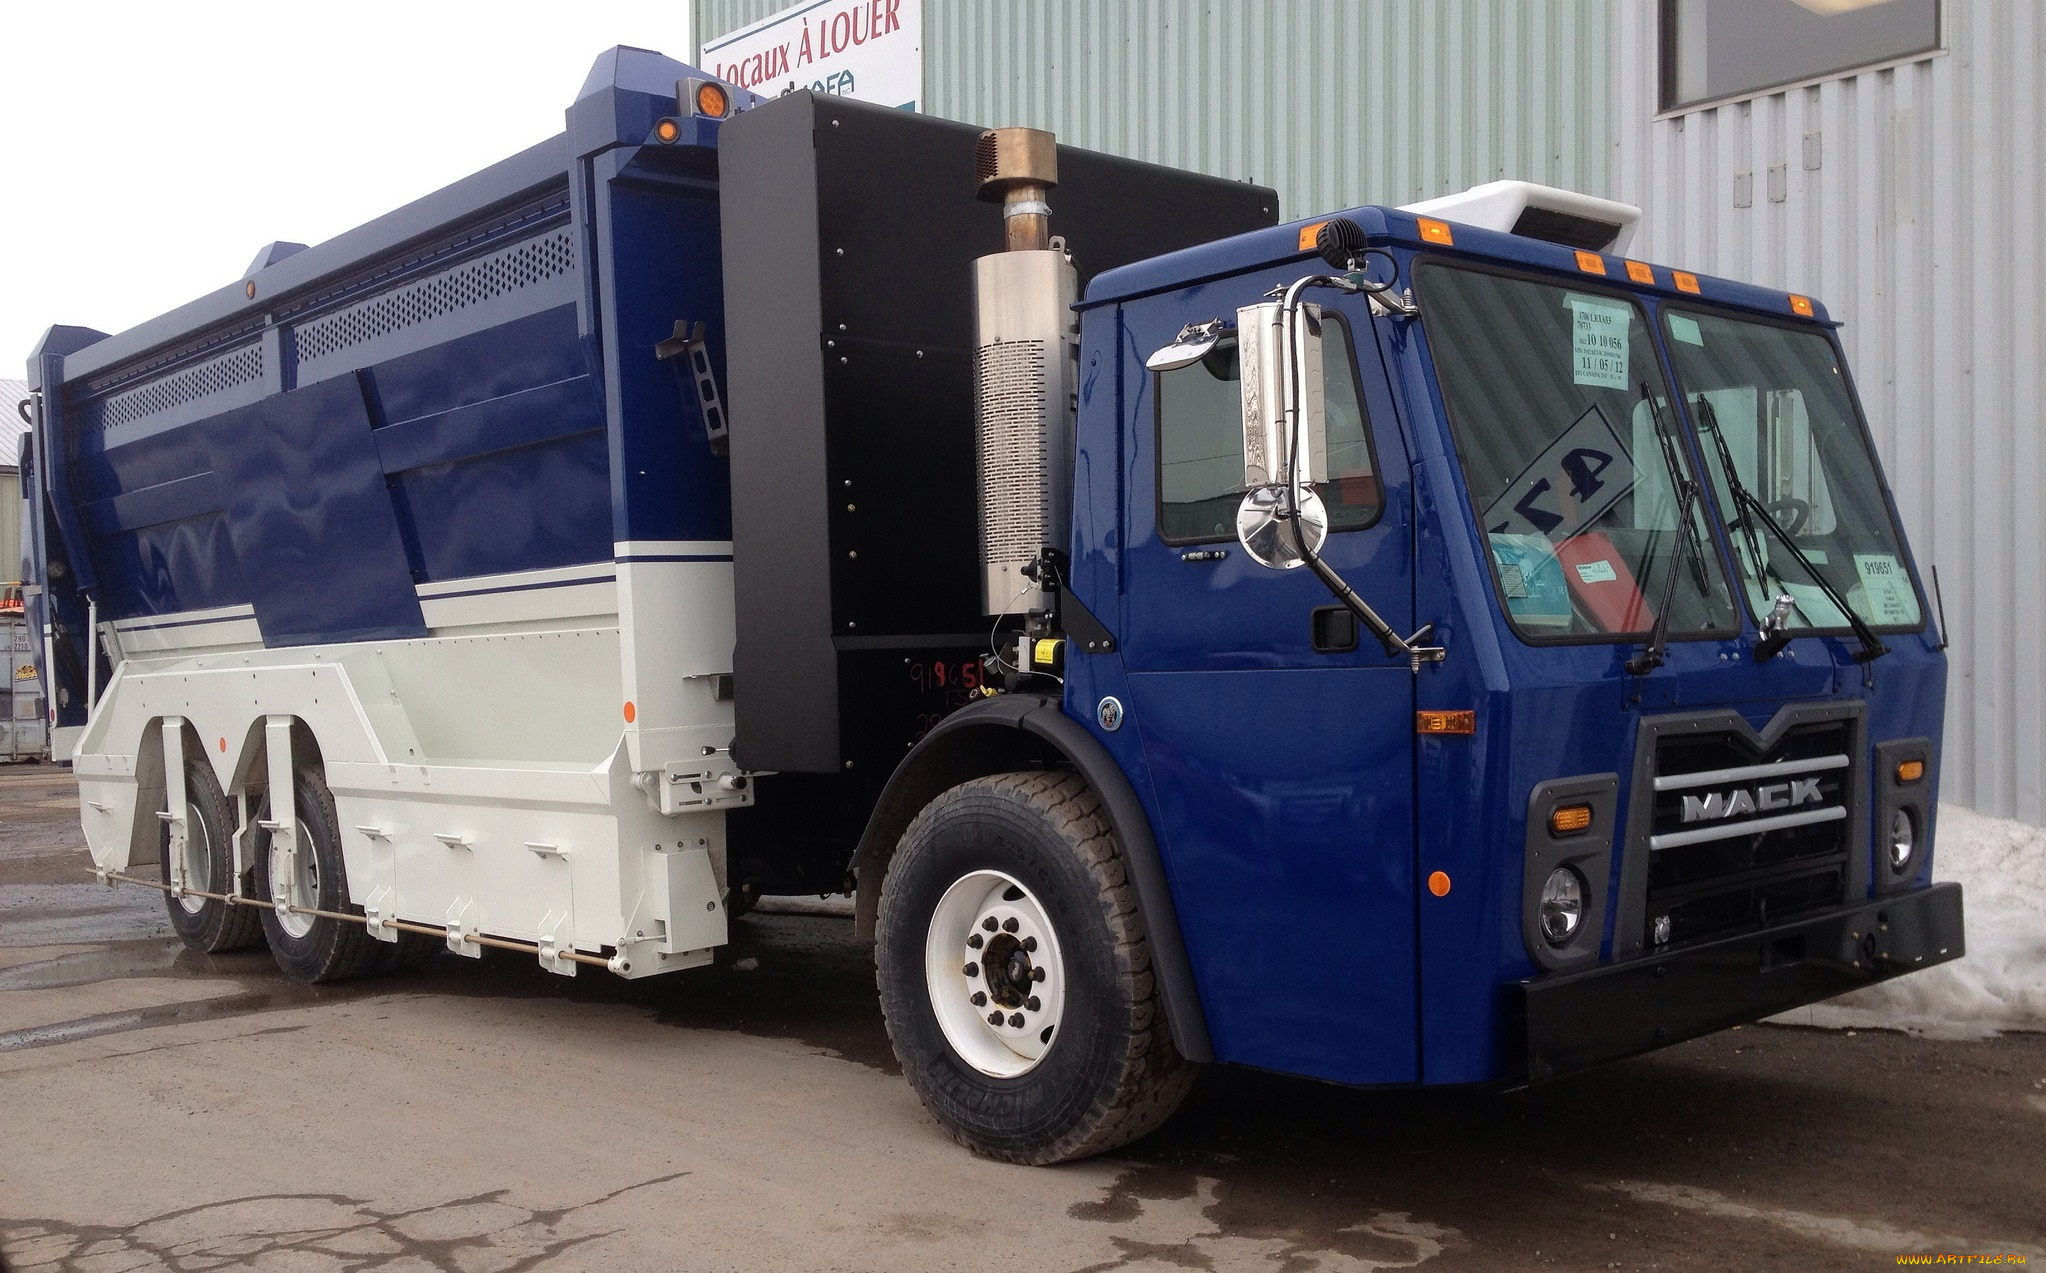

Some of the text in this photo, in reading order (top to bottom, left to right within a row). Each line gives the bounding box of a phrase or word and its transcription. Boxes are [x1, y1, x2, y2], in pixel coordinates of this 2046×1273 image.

[716, 0, 901, 89] Locaux À LOUER
[1587, 333, 1597, 346] 10
[1600, 335, 1608, 347] 10
[1609, 336, 1622, 350] 056
[1582, 357, 1591, 369] 11
[1600, 358, 1608, 371] 05
[1615, 361, 1623, 373] 12
[1864, 561, 1893, 575] 919651
[1681, 777, 1823, 822] MACK
